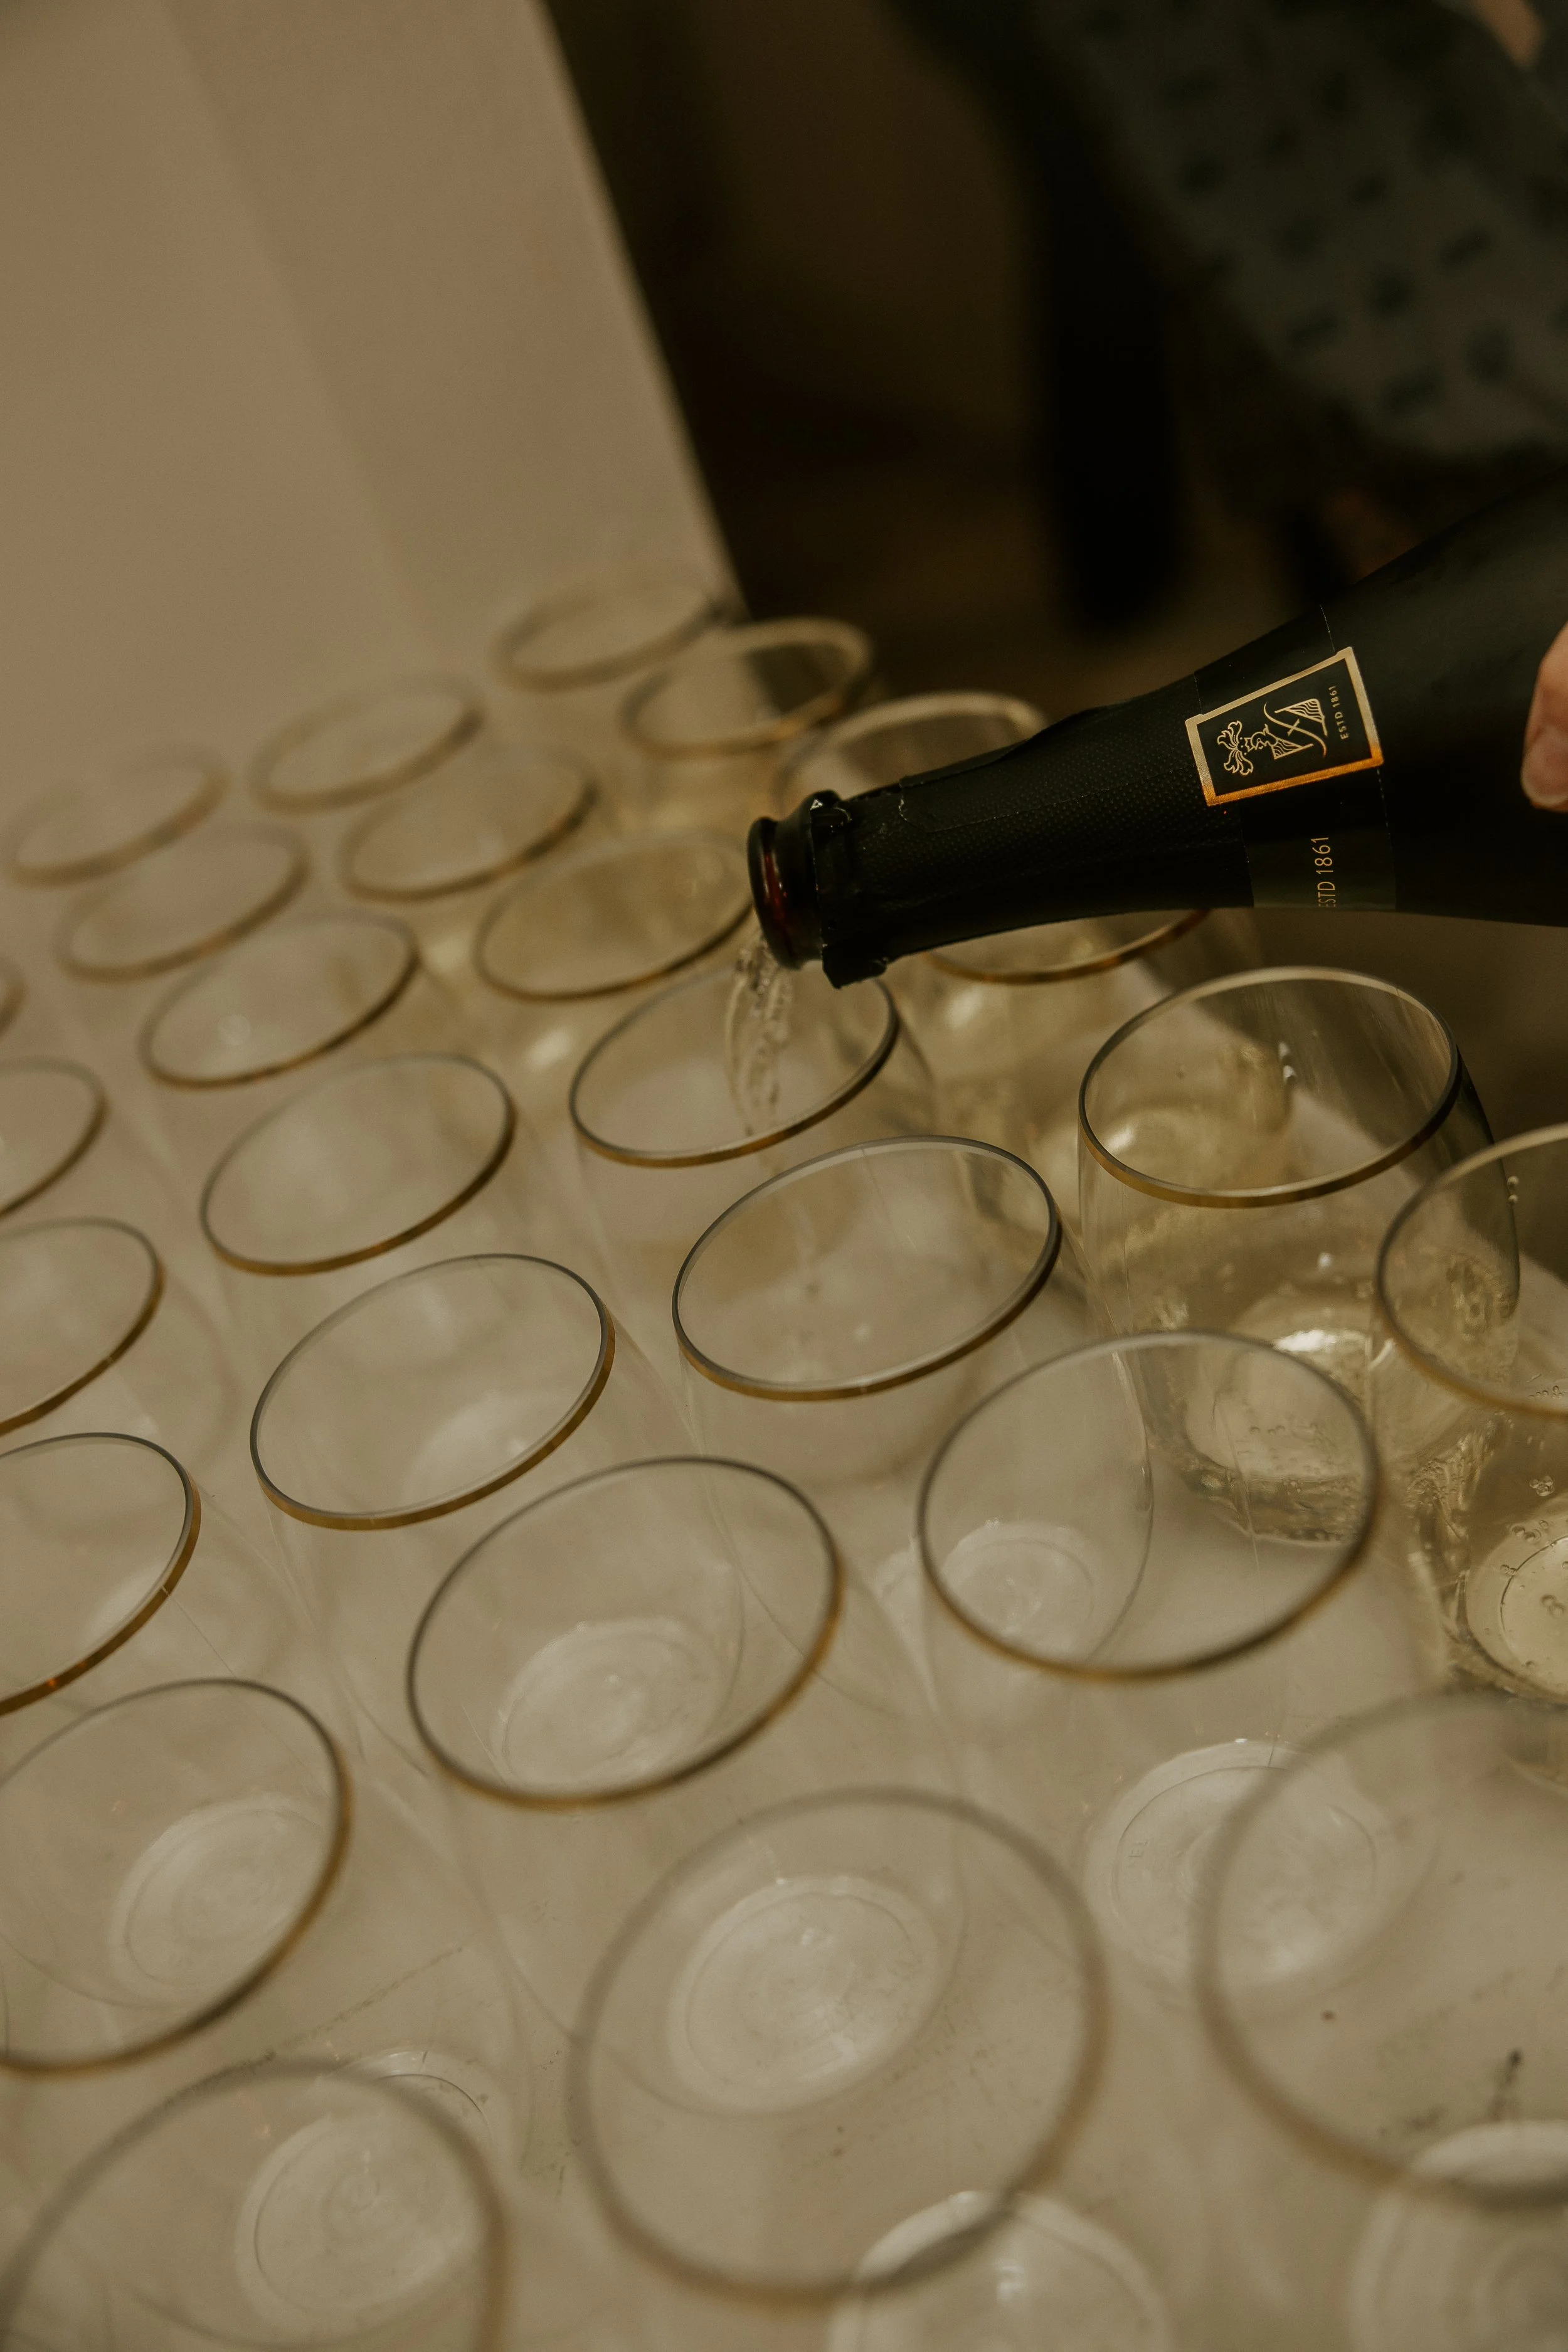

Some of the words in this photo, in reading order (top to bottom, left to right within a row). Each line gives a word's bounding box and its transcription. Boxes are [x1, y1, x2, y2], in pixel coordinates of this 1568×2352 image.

[1328, 686, 1340, 707] 1861
[1335, 712, 1349, 740] ESTD
[1310, 837, 1333, 874] 1861
